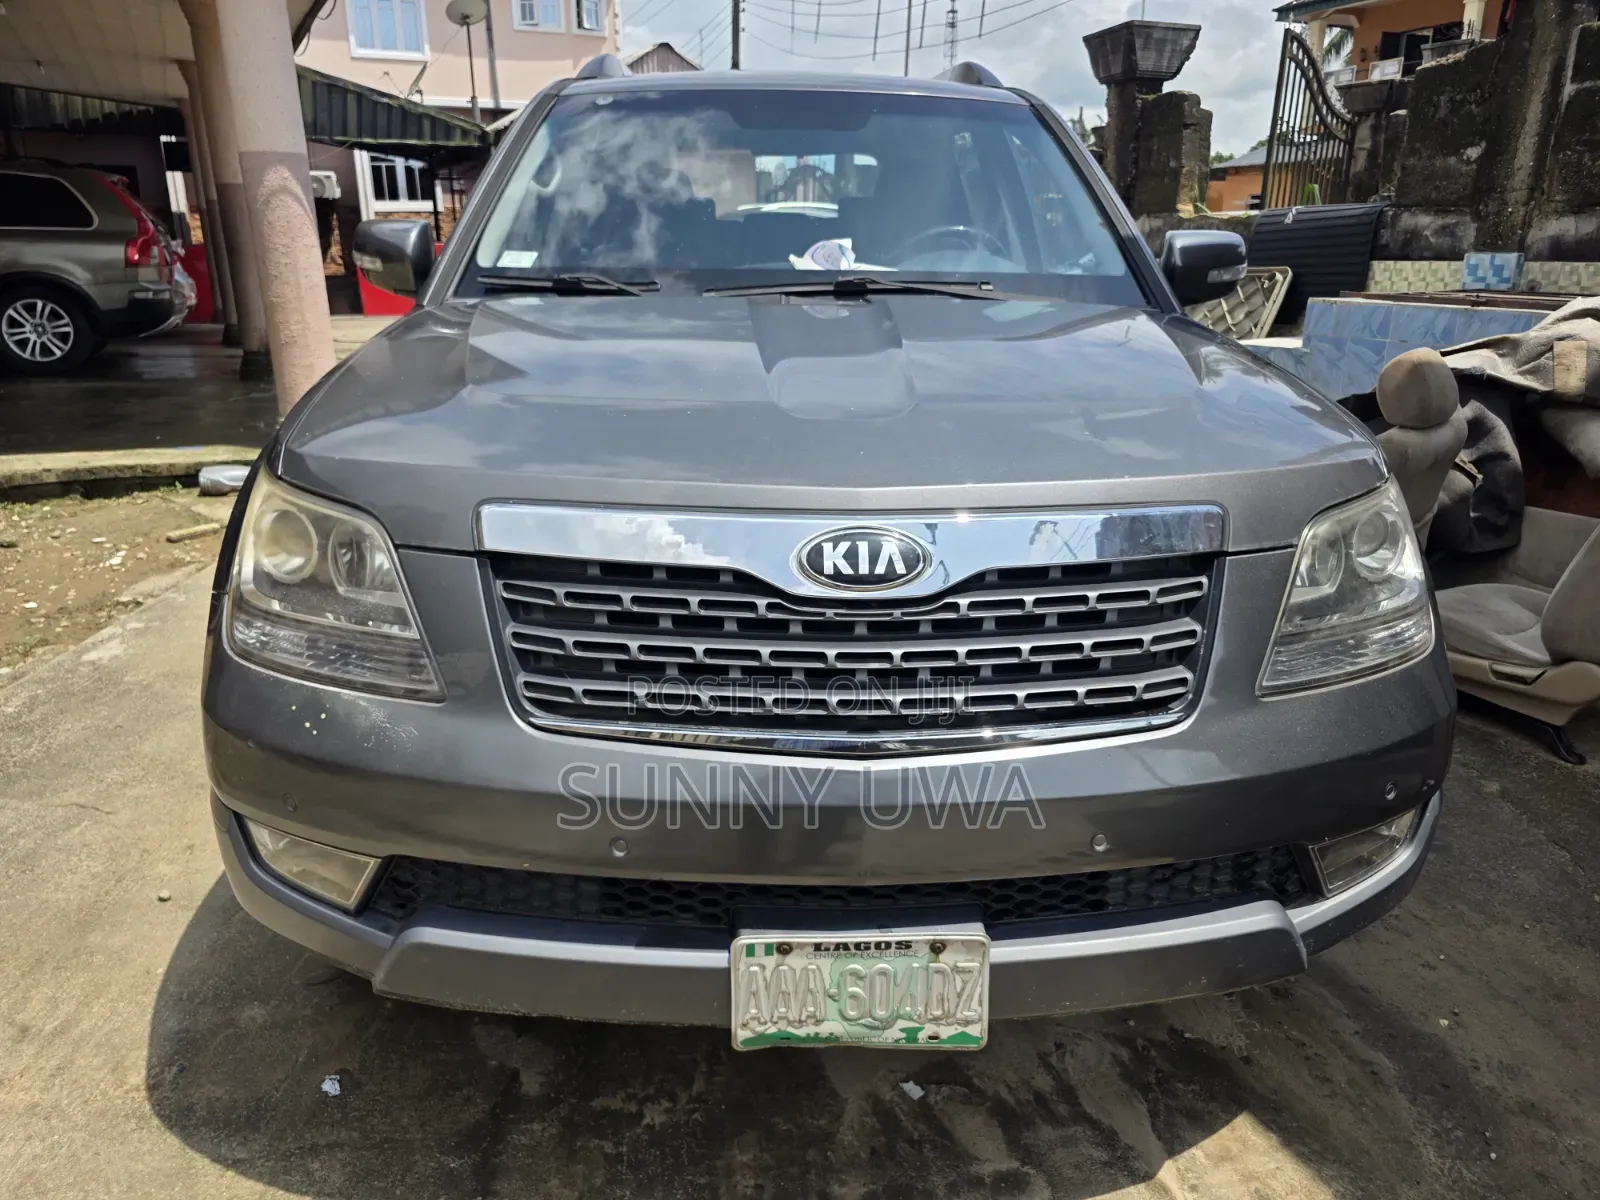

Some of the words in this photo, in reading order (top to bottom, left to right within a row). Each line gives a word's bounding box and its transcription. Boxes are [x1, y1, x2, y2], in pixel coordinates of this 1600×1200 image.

[821, 541, 907, 575] KIA
[813, 941, 913, 952] LAGOS
[805, 952, 841, 960] CENTRE
[860, 950, 919, 959] EXCELLENCE
